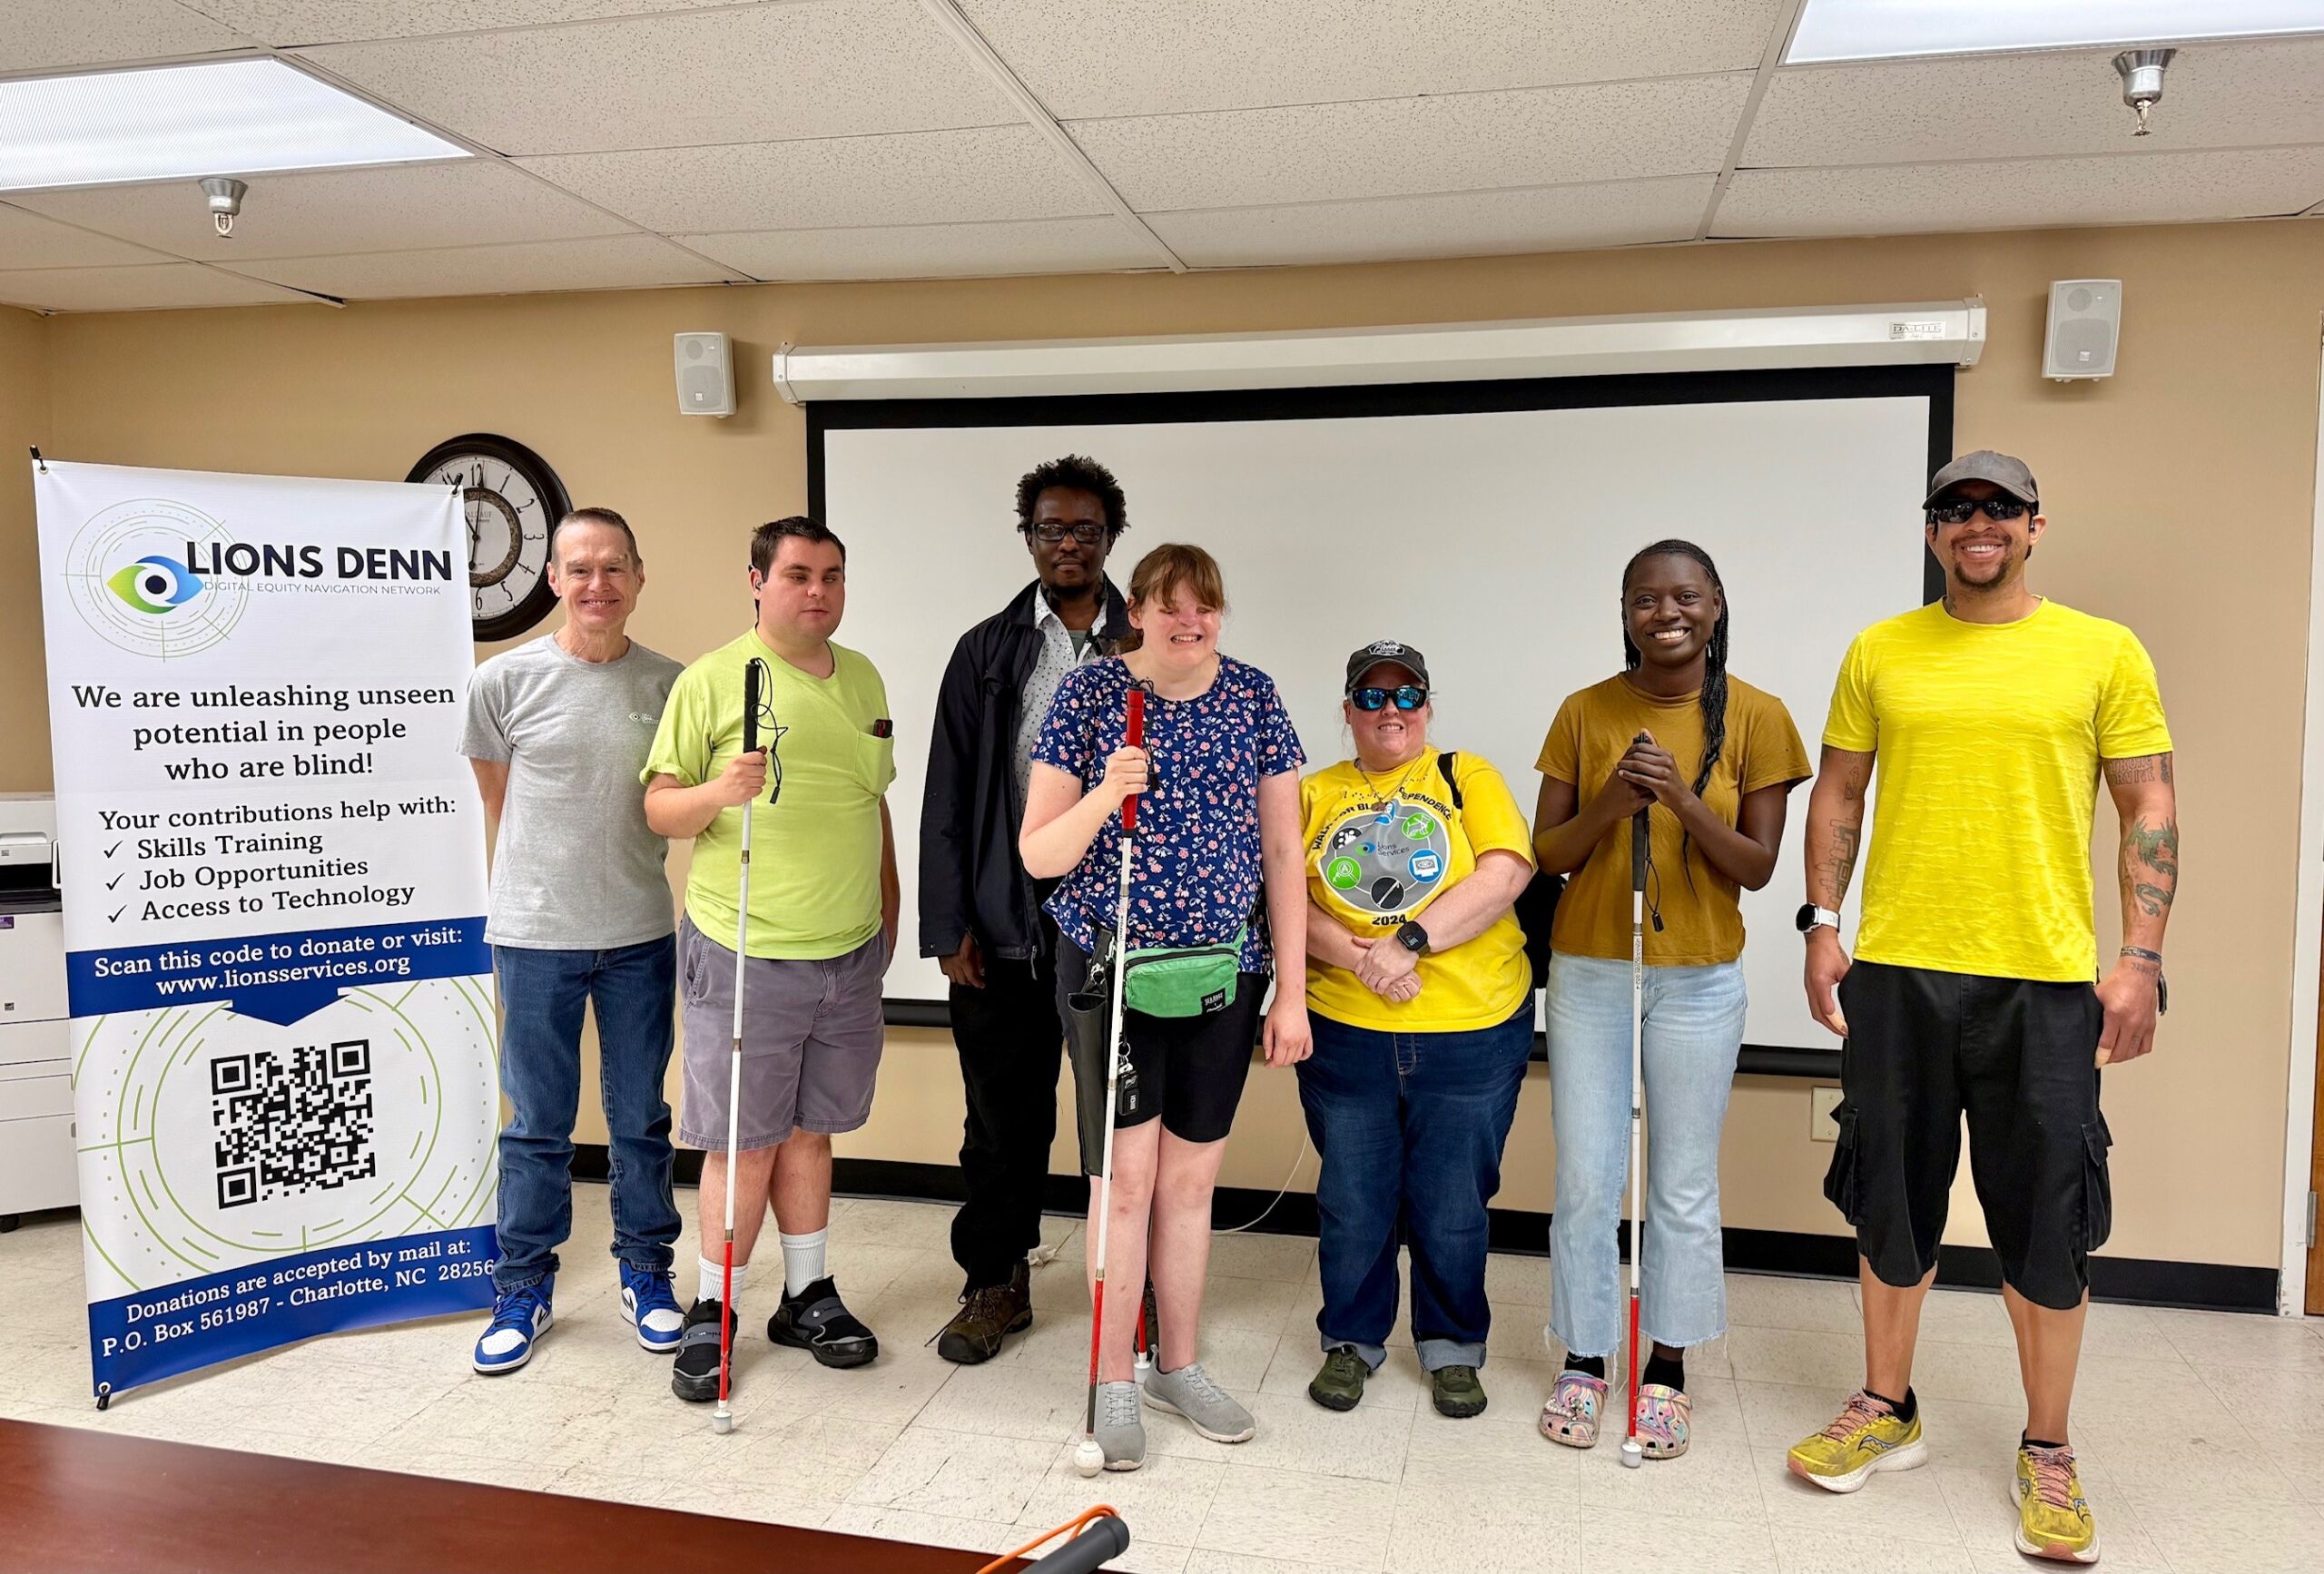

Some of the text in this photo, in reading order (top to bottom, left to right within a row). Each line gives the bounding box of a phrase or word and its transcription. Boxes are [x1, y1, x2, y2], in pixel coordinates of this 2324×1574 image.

[470, 463, 485, 488] 12
[499, 474, 510, 493] 1
[516, 498, 535, 514] 2
[187, 542, 451, 580] LIONS DENN
[204, 582, 440, 595] DIGITAL EQUITY NAVIGATION NETWORK
[475, 586, 483, 611] 6
[500, 580, 513, 602] 5
[72, 685, 455, 711] We are unleashing unseen
[133, 718, 406, 750] potential in people
[164, 753, 372, 780] who are blind!
[99, 796, 455, 830] Your contributions help with:
[138, 832, 322, 859] Skills Training
[1377, 846, 1410, 856] Services
[140, 859, 368, 890] Job Opportunities
[142, 885, 415, 920] Access to Technology
[1372, 914, 1407, 926] 2024
[95, 927, 461, 977] Scan this code to donate or visit:
[156, 956, 410, 995] www.lionsservices.org
[126, 1240, 470, 1323] Donations are accepted by mail at:
[103, 1332, 146, 1356] P.O.
[154, 1322, 193, 1343] Box
[201, 1297, 270, 1330] 561987
[290, 1276, 389, 1306] Charlotte,
[396, 1268, 426, 1286] NC
[438, 1259, 494, 1280] 28256
